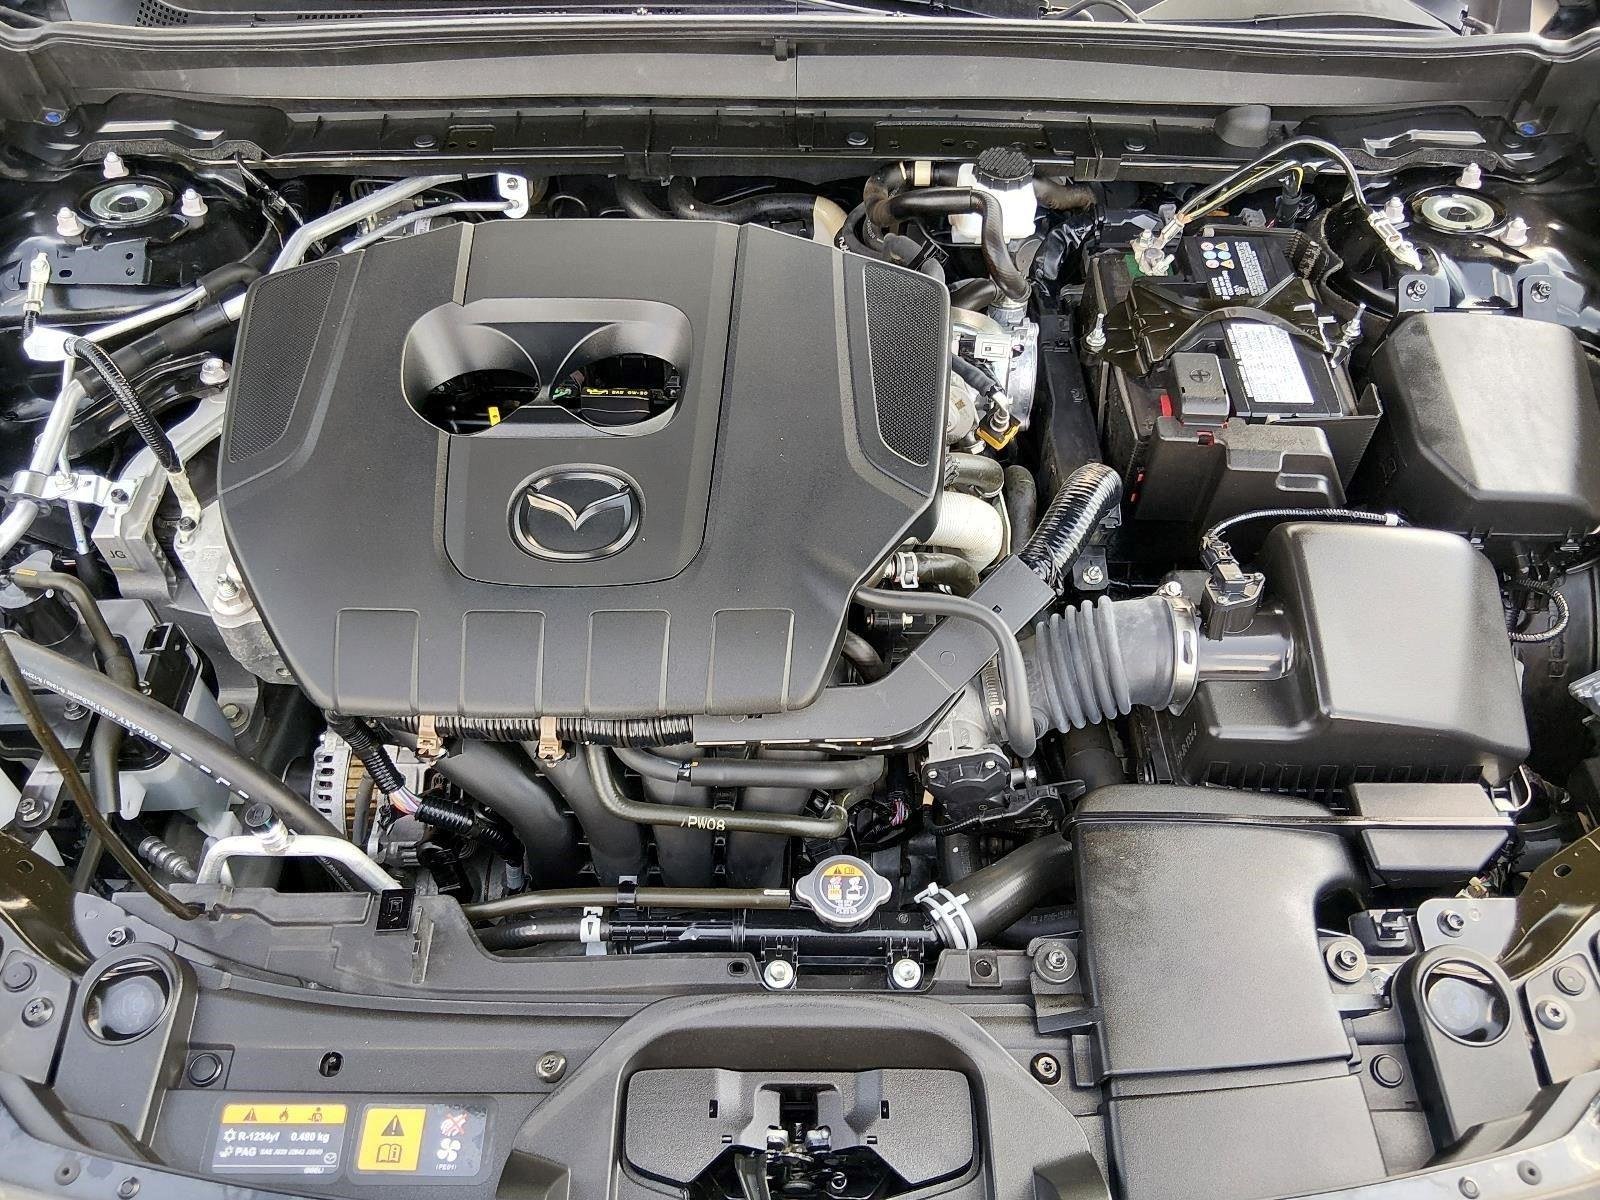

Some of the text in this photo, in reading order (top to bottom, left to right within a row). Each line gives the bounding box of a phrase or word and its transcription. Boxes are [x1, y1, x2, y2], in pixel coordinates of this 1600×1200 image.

[117, 716, 159, 742] GALAXY
[238, 1131, 281, 1144] R-1234yf
[317, 1131, 330, 1143] kg
[235, 1147, 257, 1156] PAG
